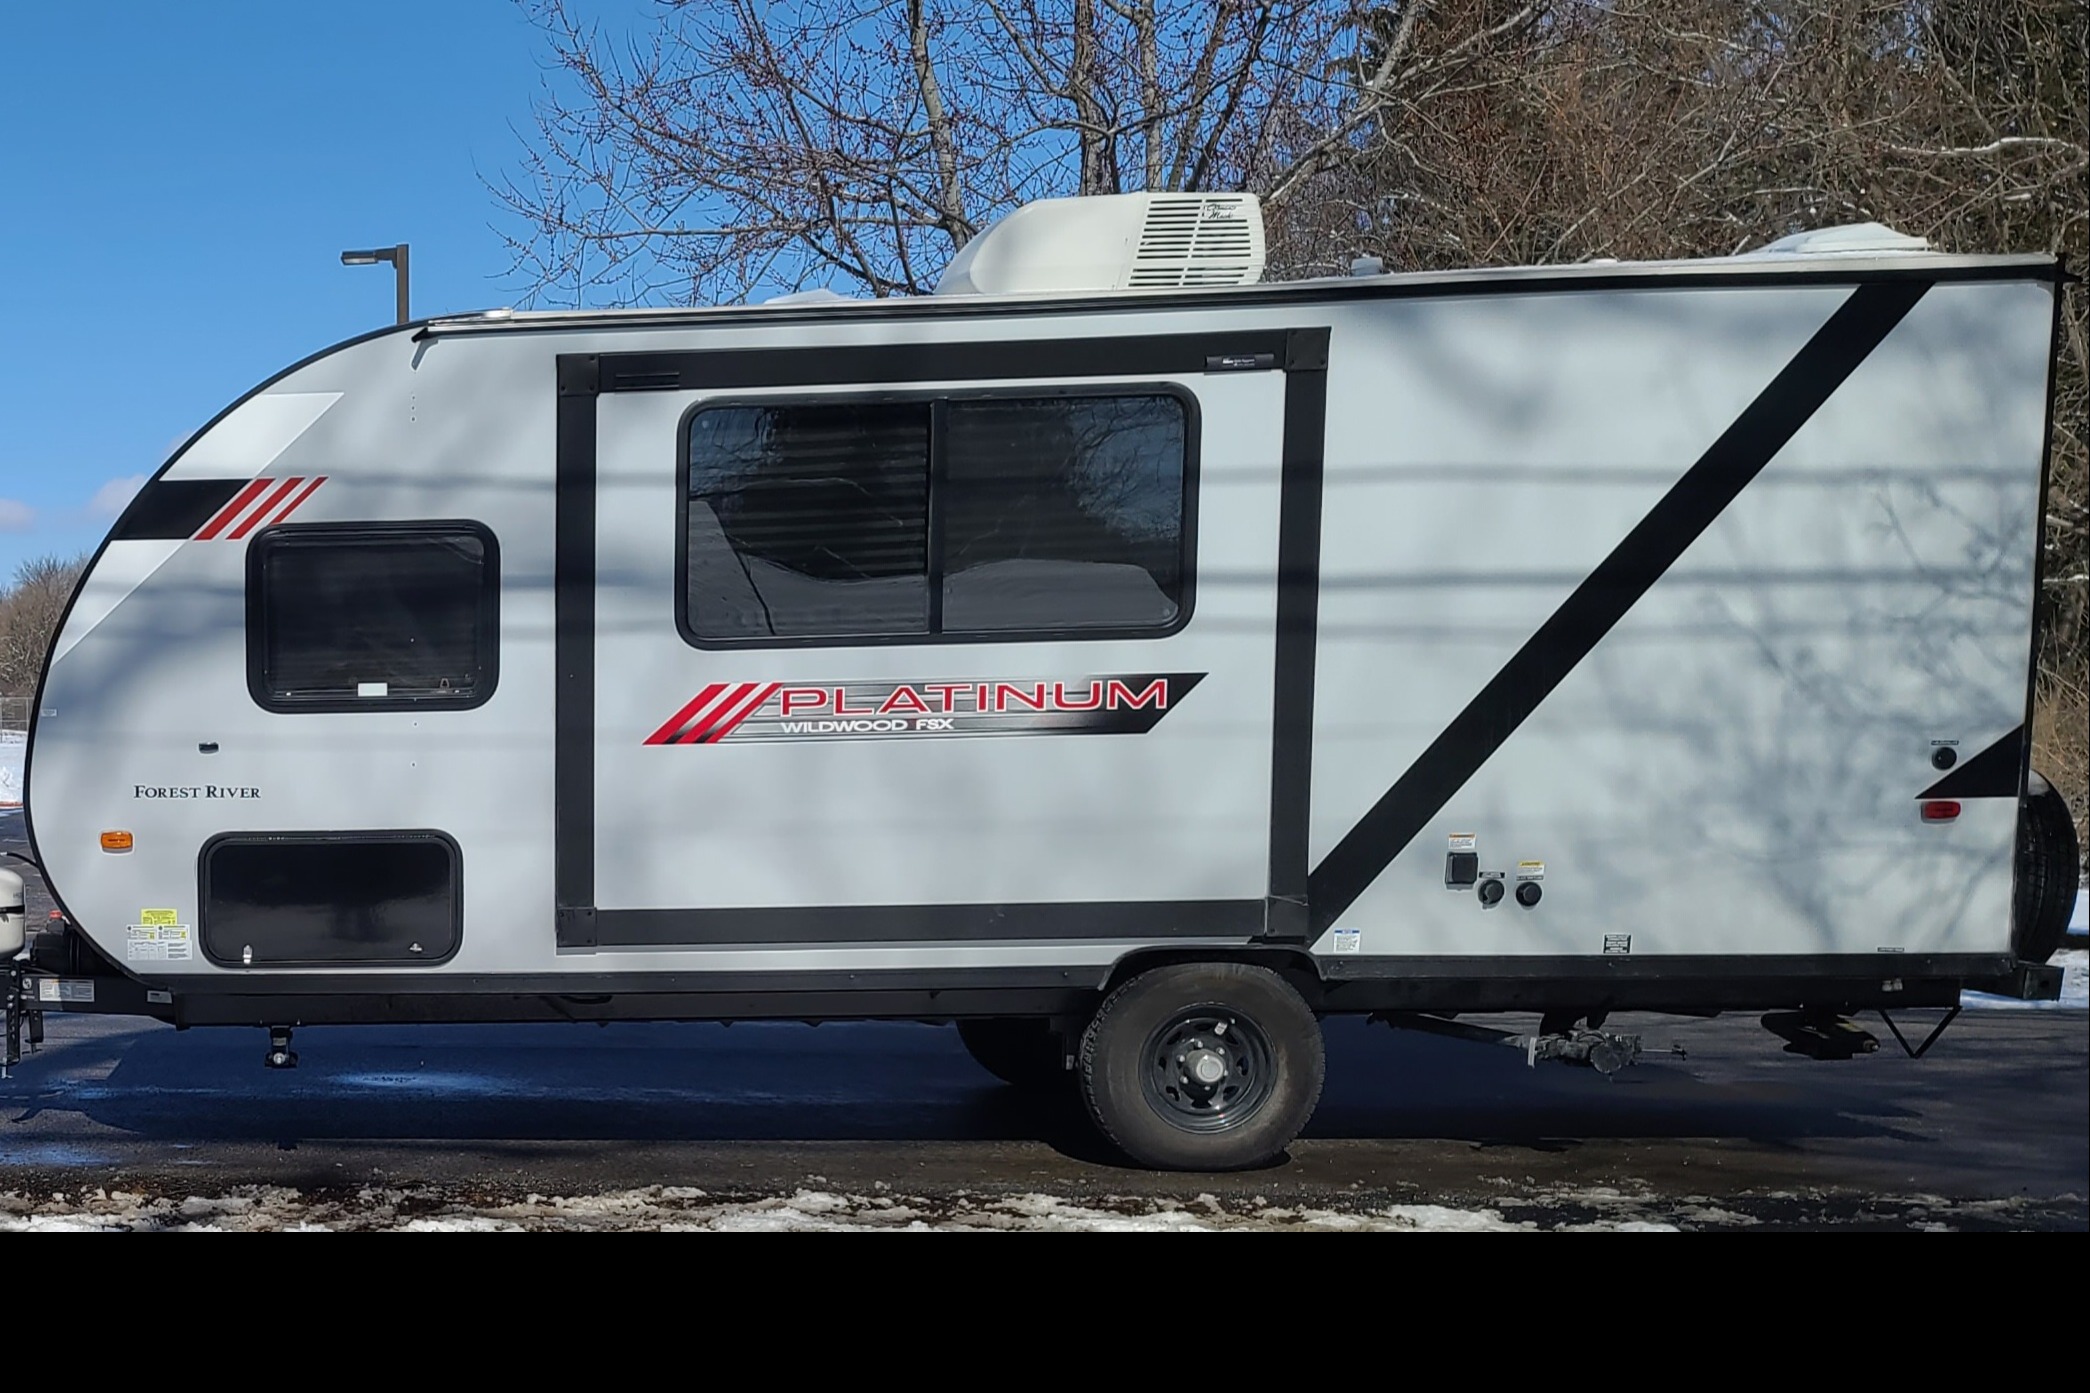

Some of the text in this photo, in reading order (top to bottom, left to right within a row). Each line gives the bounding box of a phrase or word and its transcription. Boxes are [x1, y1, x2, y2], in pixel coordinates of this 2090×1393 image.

[780, 679, 1169, 717] PLATINUM
[781, 717, 954, 733] WILDWOOD FSX
